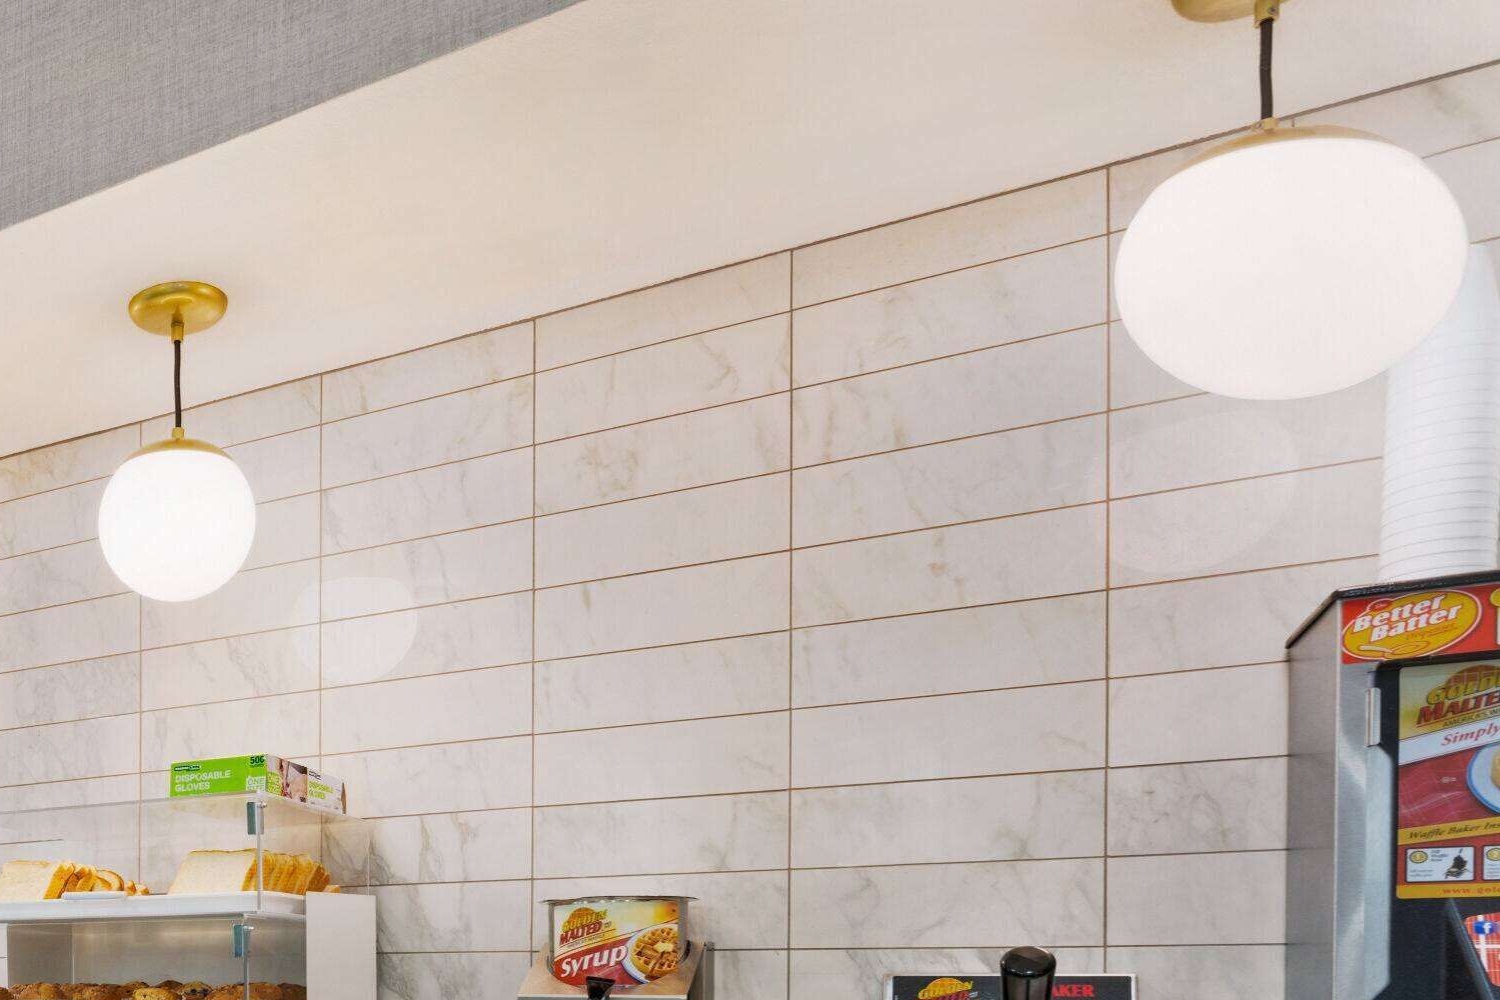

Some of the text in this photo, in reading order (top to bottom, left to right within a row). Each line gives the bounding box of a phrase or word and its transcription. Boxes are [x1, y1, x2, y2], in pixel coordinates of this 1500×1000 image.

[1354, 594, 1445, 632] Better
[1370, 605, 1462, 642] Batter
[1442, 722, 1500, 746] Simply
[175, 769, 232, 783] DISPOSABLE
[175, 782, 211, 792] GLOVES
[1409, 828, 1445, 840] Waffle
[1448, 823, 1480, 835] Baker
[561, 945, 628, 977] Syrup
[1051, 984, 1095, 998] AKER
